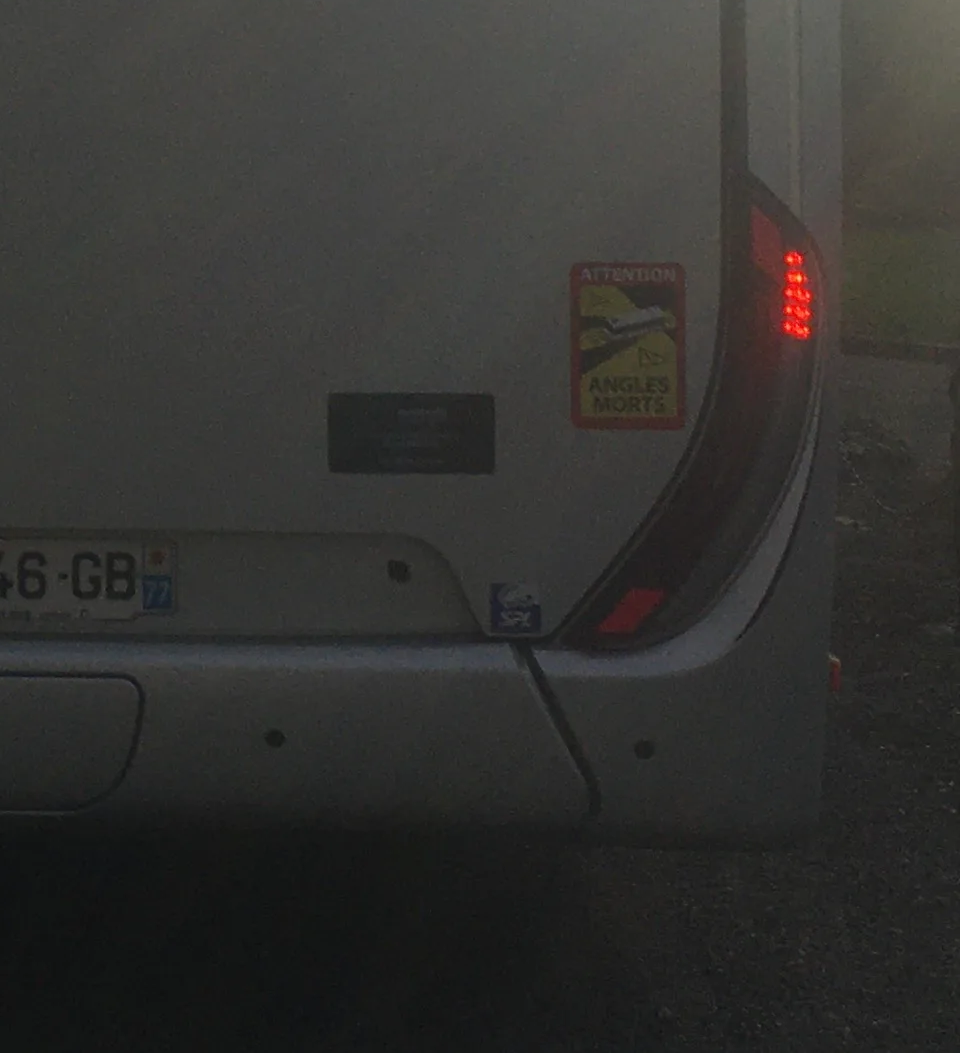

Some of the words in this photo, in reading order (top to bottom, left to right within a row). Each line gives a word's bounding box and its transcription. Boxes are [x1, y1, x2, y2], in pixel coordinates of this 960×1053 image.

[580, 267, 676, 282] ATTENTION
[589, 376, 670, 394] ANGLES
[592, 395, 665, 413] MORTS
